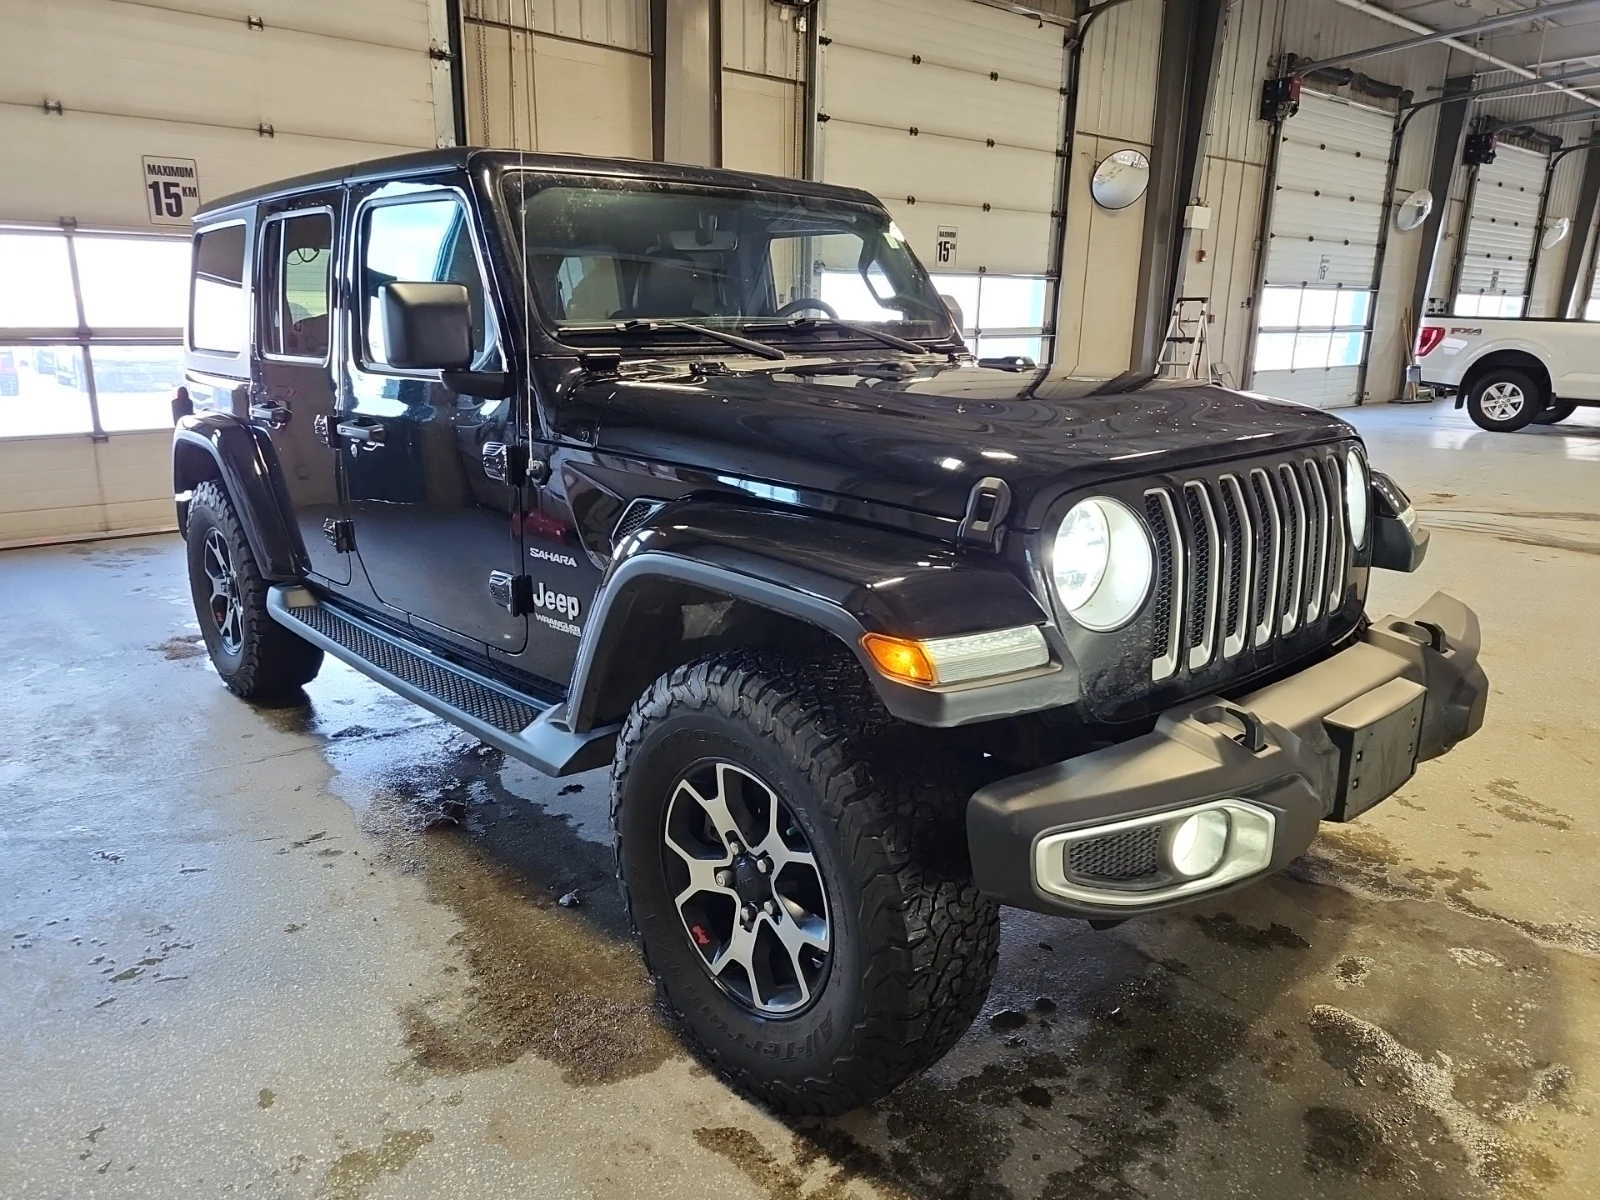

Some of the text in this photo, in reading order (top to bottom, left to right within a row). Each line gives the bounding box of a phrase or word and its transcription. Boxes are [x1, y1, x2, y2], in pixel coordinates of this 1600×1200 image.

[147, 163, 194, 178] MAXIMUM
[148, 181, 197, 217] 15 KM
[938, 240, 950, 263] 15
[1450, 327, 1482, 335] FX4
[529, 547, 578, 568] SAHARA
[532, 582, 580, 620] Jeep
[535, 612, 581, 633] WRANGLER
